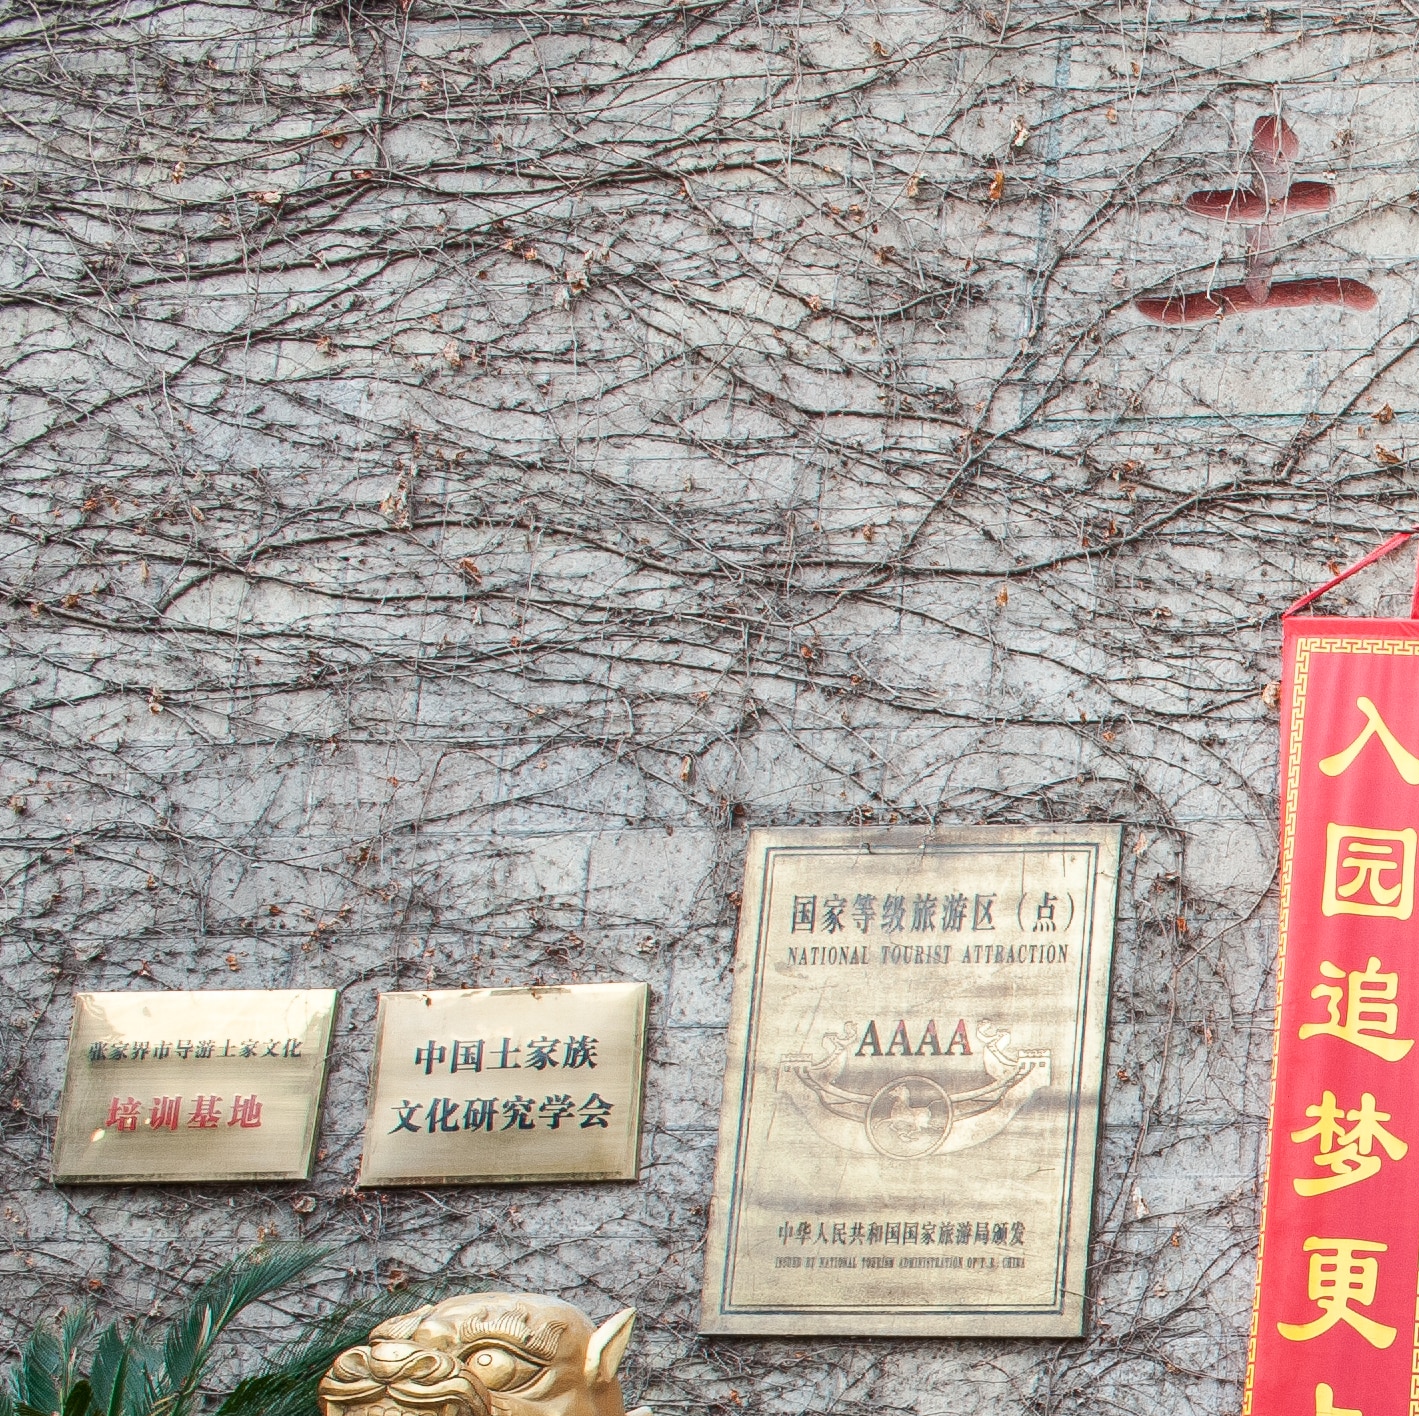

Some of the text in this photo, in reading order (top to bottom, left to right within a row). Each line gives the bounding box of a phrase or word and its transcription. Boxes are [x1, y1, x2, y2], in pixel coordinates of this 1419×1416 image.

[788, 943, 1069, 965] NATIONAL TOURIST ATTRACTION
[414, 1035, 599, 1075] 中国土家族
[855, 1018, 973, 1056] AAAA
[105, 1093, 263, 1131] 培训基地
[387, 1092, 614, 1135] 文化研究学会
[777, 1220, 1026, 1246] 中华人民共和国国家旅游局颁发
